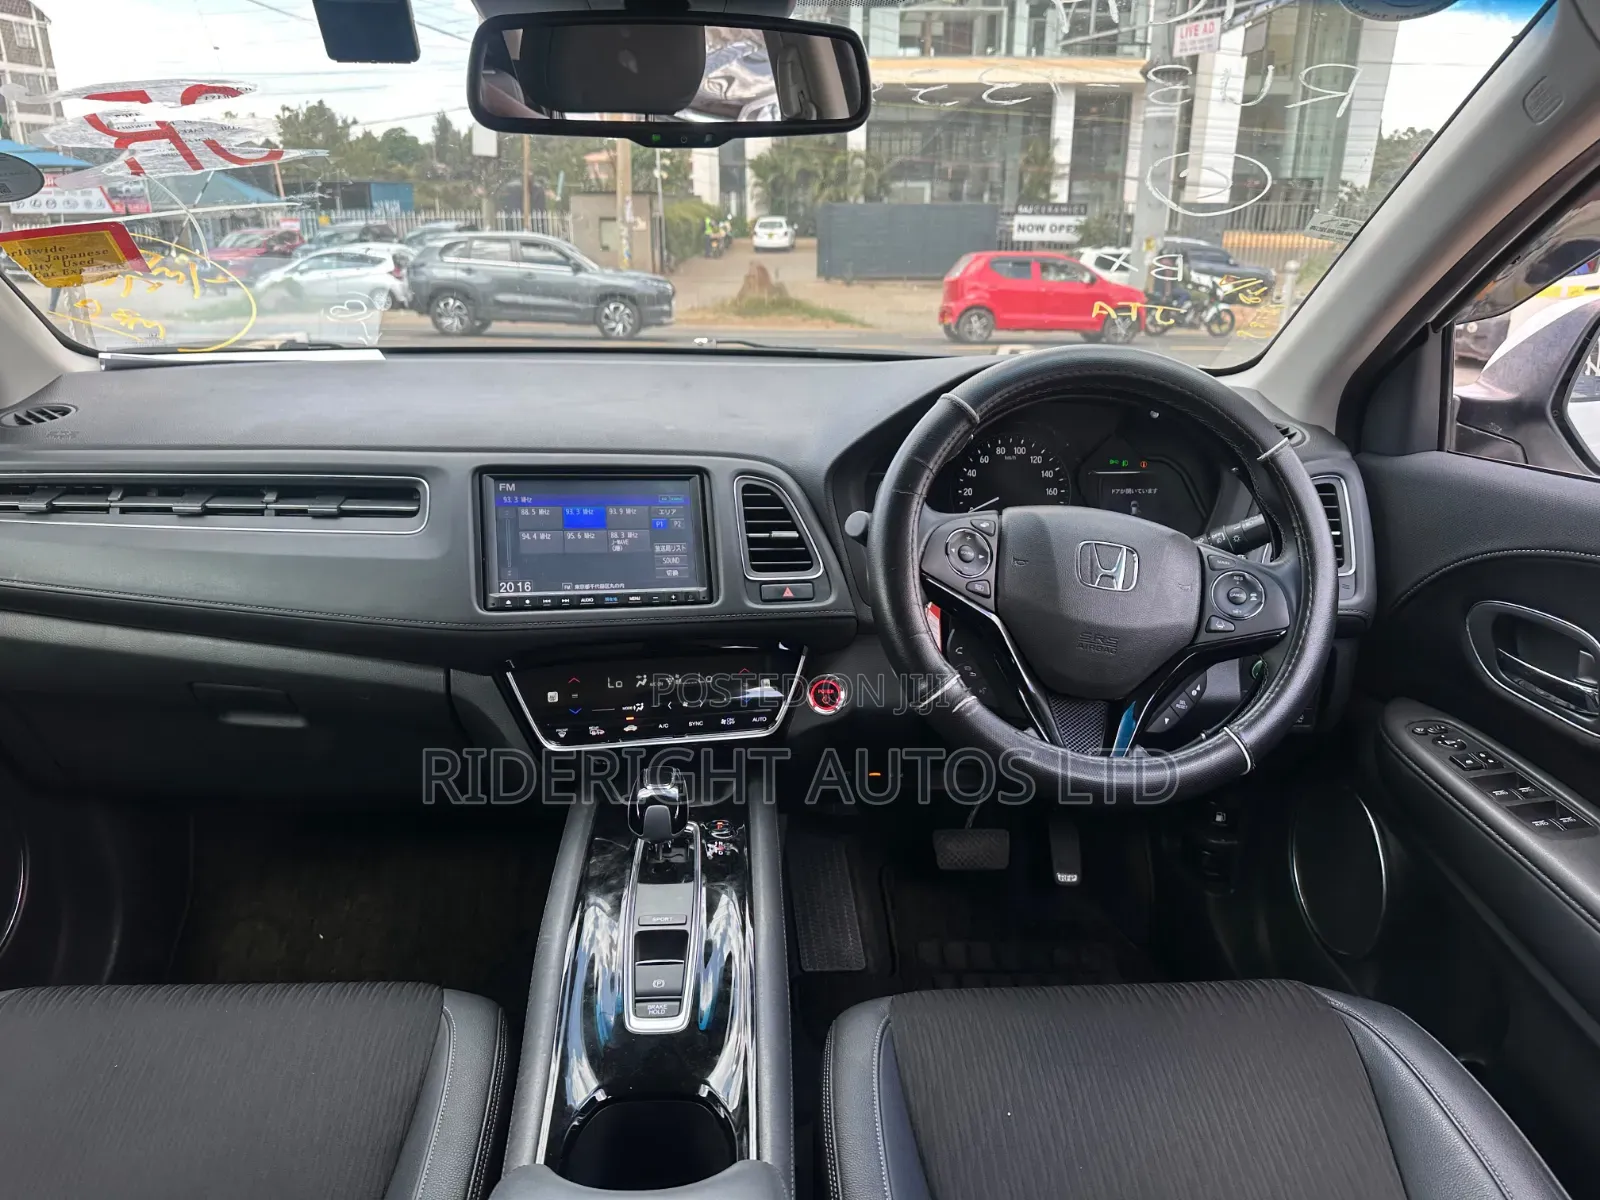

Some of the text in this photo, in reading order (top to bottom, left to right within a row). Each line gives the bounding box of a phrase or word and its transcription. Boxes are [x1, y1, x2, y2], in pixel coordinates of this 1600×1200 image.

[1180, 23, 1199, 39] LIVE
[1017, 223, 1046, 234] NOW
[7, 245, 66, 258] rldwide
[45, 248, 109, 263] Japanese
[62, 258, 95, 269] Used
[33, 271, 58, 279] Car
[996, 446, 1026, 455] 80 100
[979, 455, 989, 463] 60
[1030, 456, 1042, 464] 120
[967, 469, 977, 477] 40
[1041, 470, 1054, 478] 140
[499, 483, 516, 492] FM
[963, 487, 973, 496] 20
[1046, 487, 1058, 496] 160
[503, 496, 519, 504] 93.3
[520, 508, 536, 516] 88.5
[565, 508, 580, 516] 93.3
[609, 507, 637, 515] 93.9 MHz
[658, 508, 677, 516] エリア
[655, 520, 663, 528] P1
[673, 520, 681, 528] P2
[521, 532, 551, 541] 94.4 MHz
[566, 532, 581, 540] 95.6
[610, 531, 639, 539] 88.3 MHz
[662, 556, 680, 564] SOUND
